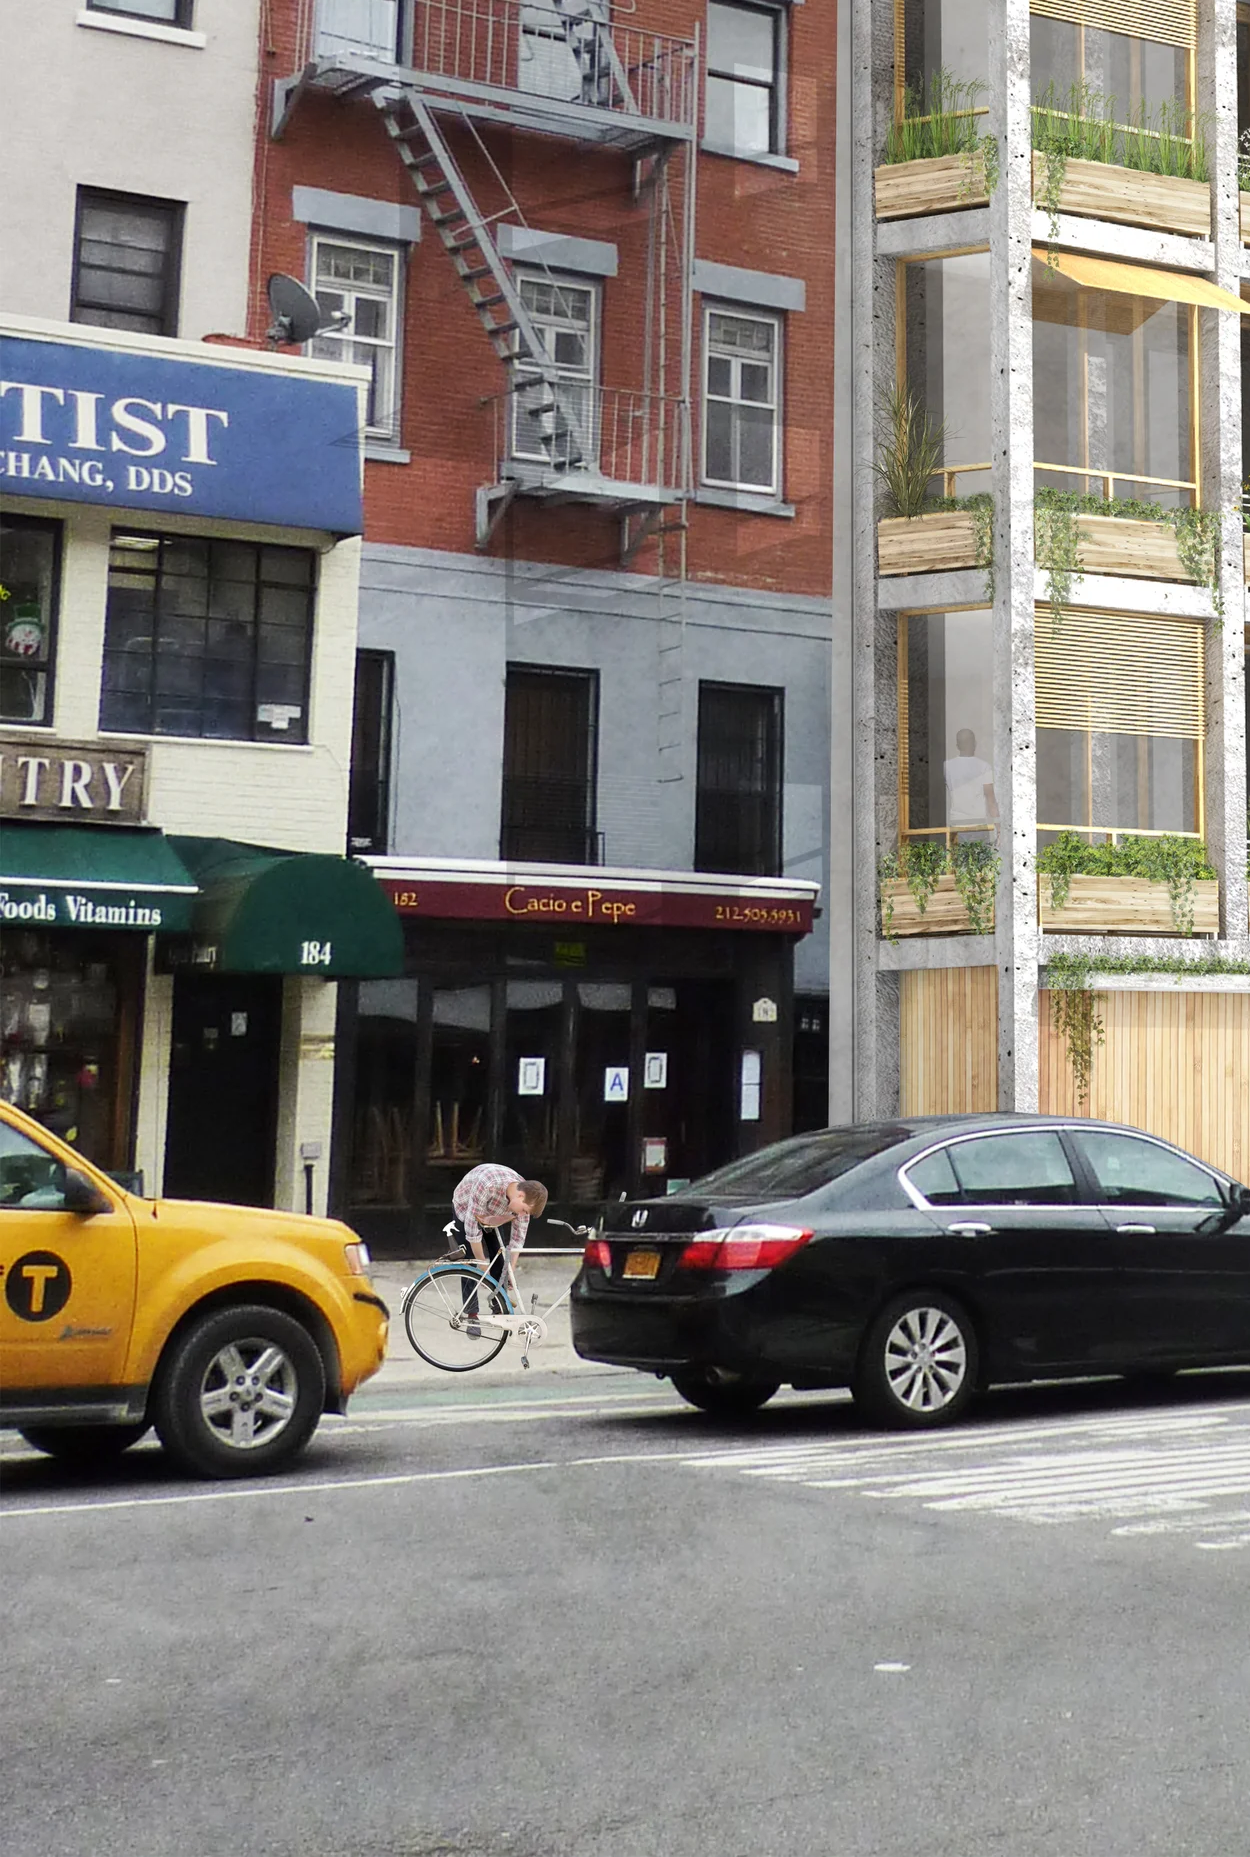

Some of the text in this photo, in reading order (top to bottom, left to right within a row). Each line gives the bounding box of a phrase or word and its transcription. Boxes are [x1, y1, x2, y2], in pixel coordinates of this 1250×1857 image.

[0, 450, 194, 498] HANG, DDS
[0, 754, 136, 811] TRY
[65, 894, 162, 926] Vitamins
[505, 886, 567, 914] Cacio
[571, 900, 583, 913] e
[588, 890, 637, 924] Pepe
[300, 940, 332, 966] 184
[610, 1072, 624, 1092] A
[22, 1265, 58, 1313] T
